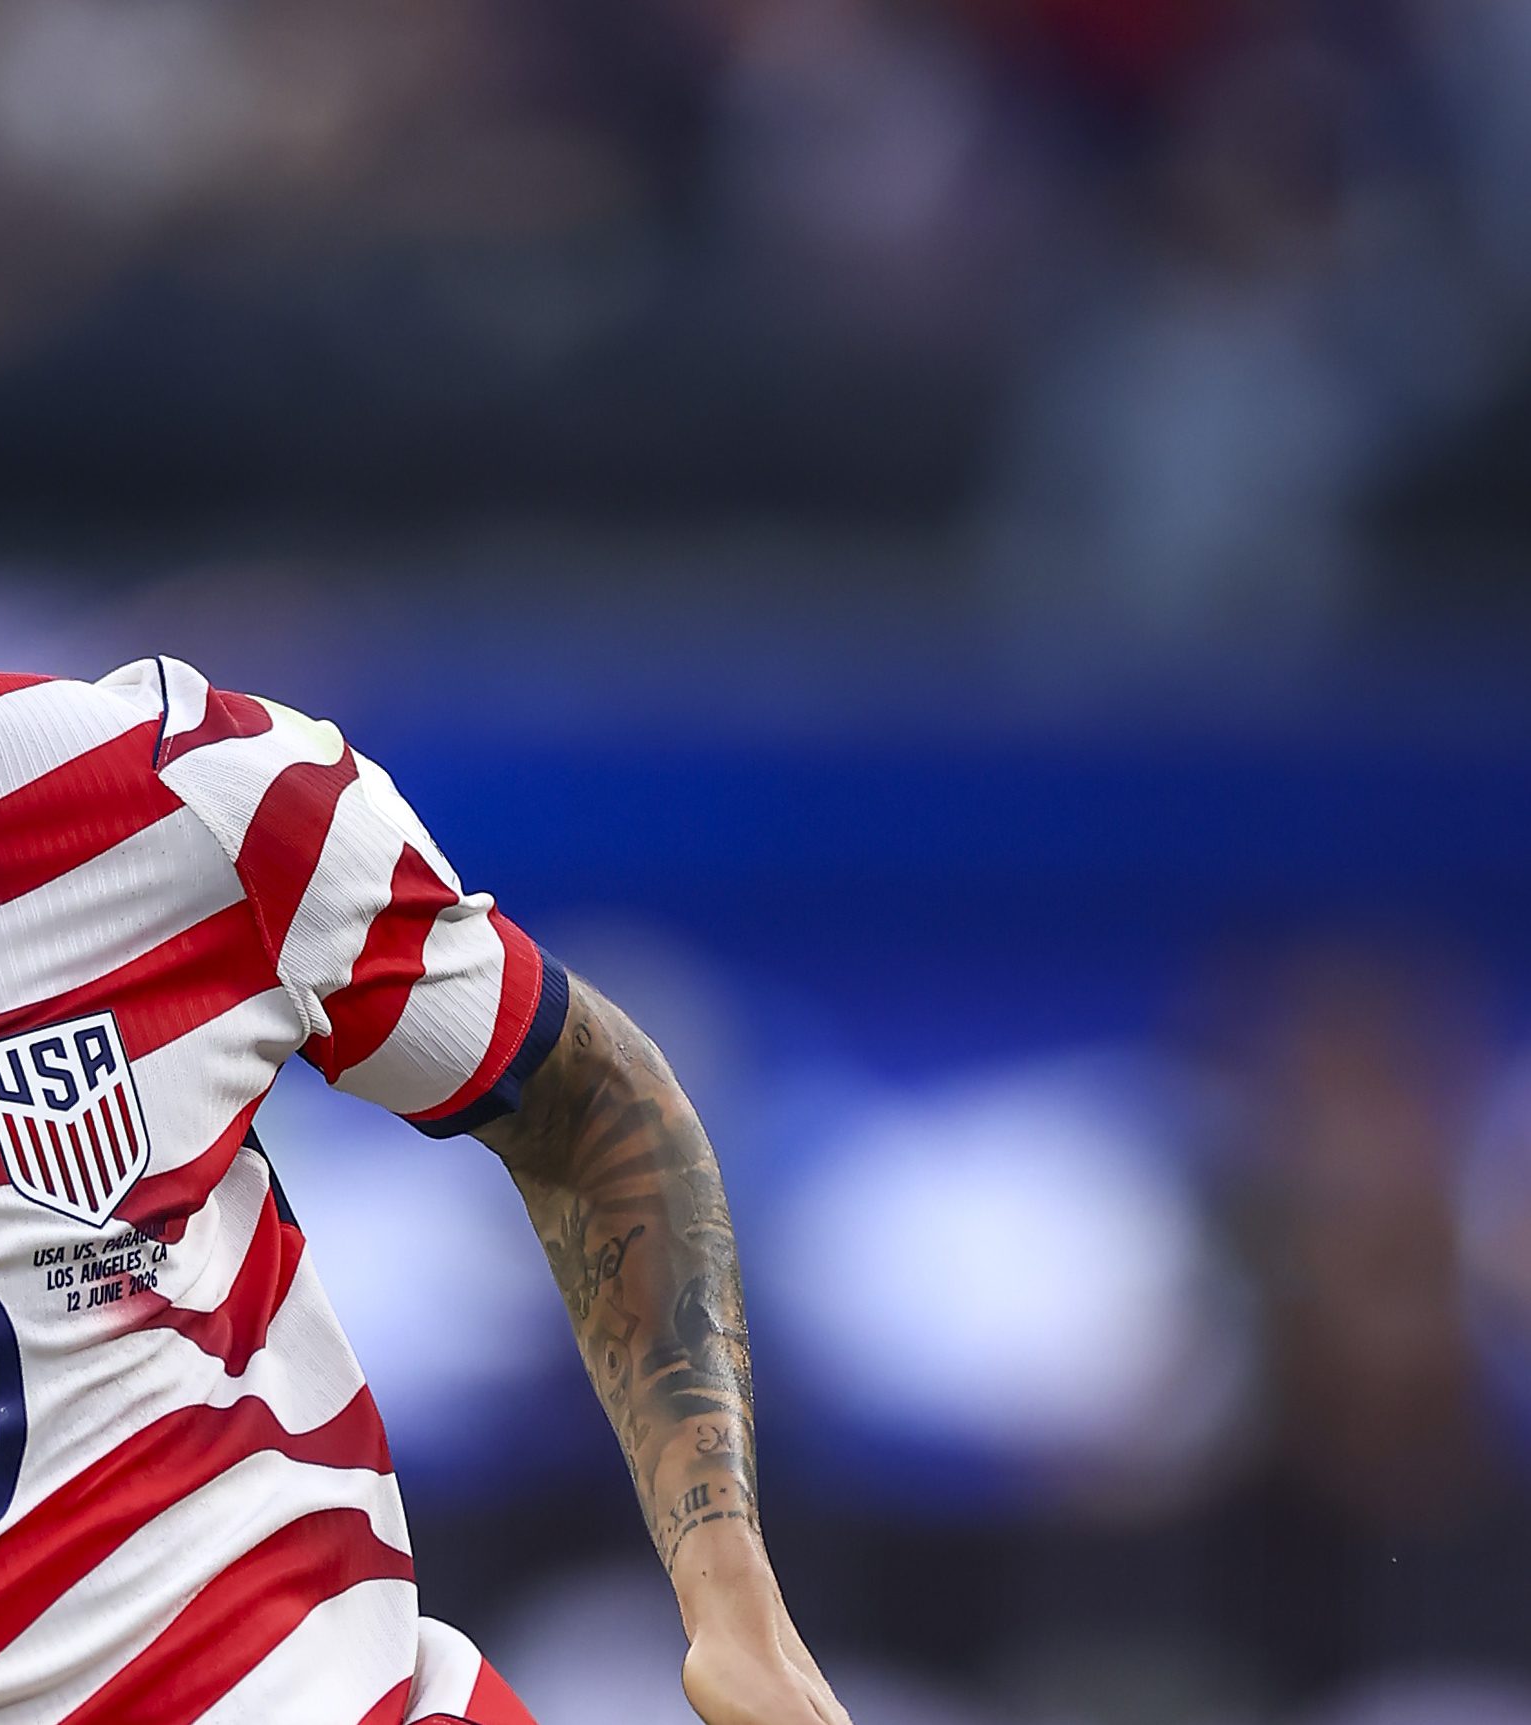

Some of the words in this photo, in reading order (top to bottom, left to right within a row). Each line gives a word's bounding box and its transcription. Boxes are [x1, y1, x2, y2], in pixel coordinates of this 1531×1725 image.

[33, 1246, 65, 1267] USA
[73, 1242, 96, 1260] VS.
[47, 1266, 74, 1291] LOS
[80, 1249, 147, 1284] ANGELES,
[151, 1242, 168, 1263] CA
[66, 1291, 81, 1312] 12
[86, 1281, 123, 1308] JUNE
[128, 1268, 158, 1297] 2026
